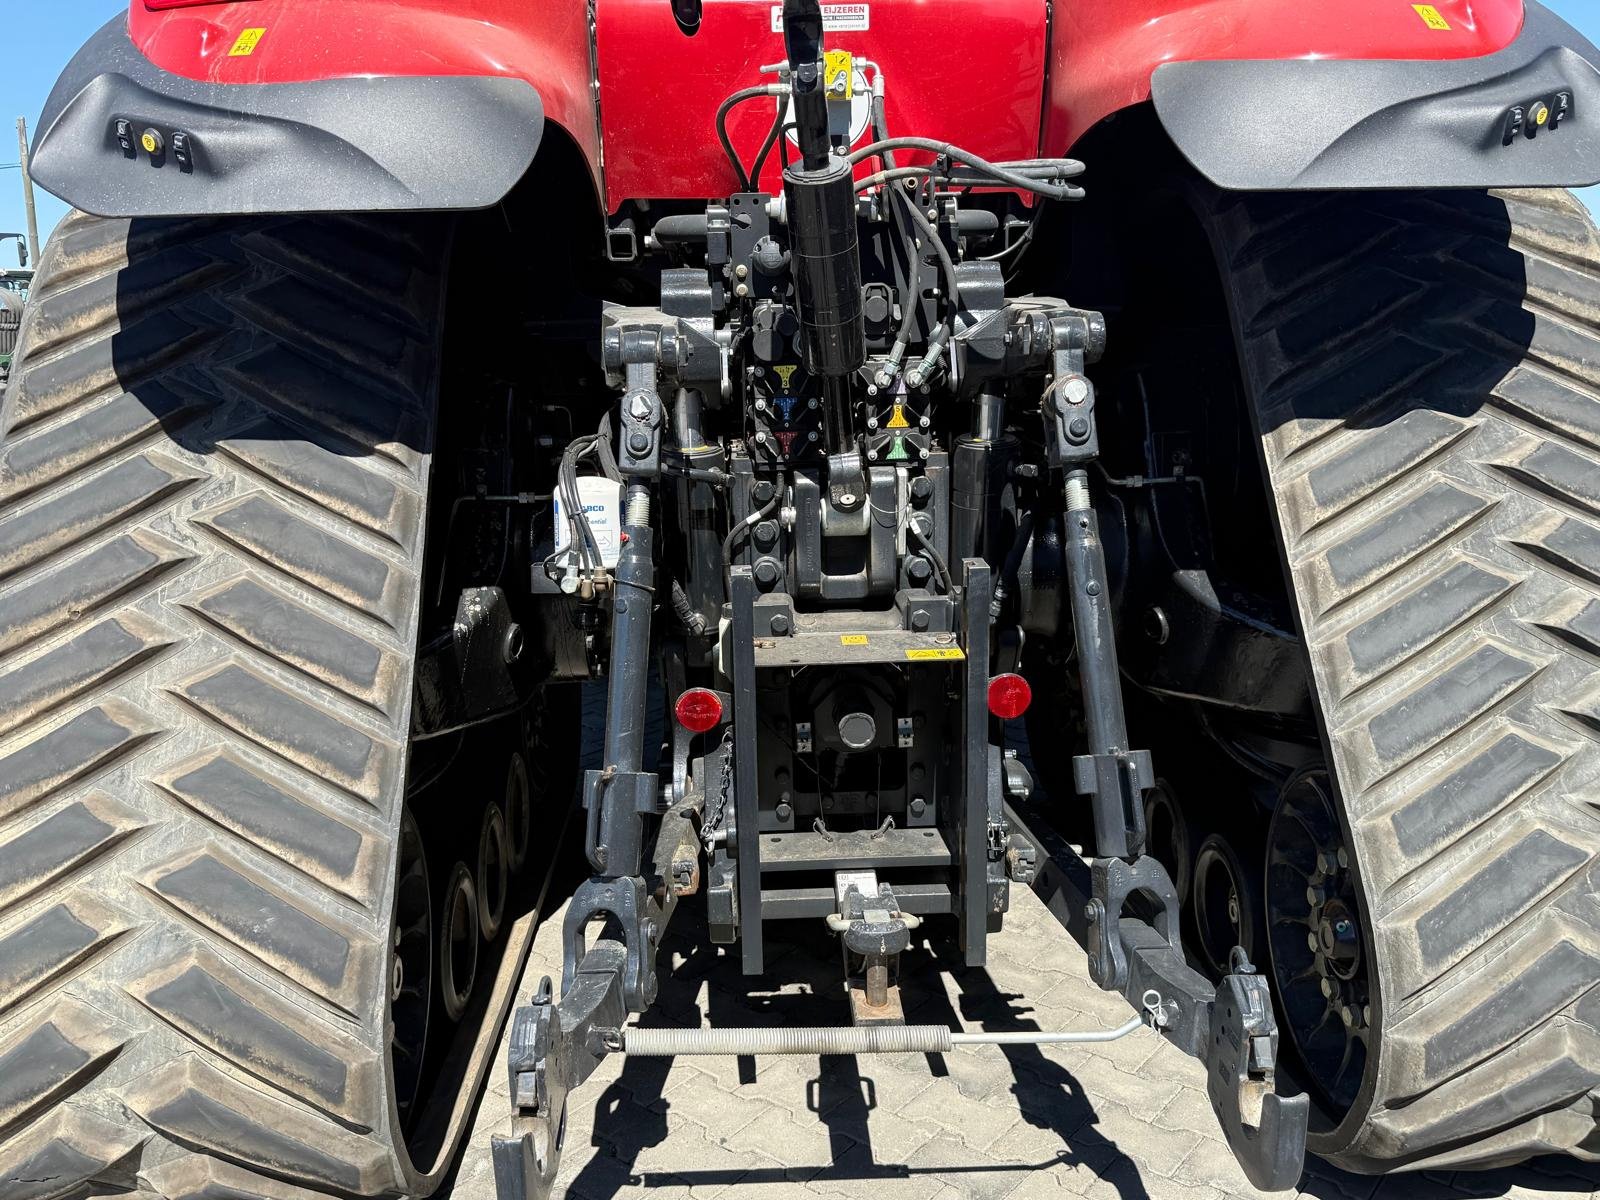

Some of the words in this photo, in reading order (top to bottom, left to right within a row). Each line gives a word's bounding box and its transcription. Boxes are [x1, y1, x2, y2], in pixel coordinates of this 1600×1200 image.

[824, 6, 865, 14] EIJZEREN
[783, 379, 788, 387] 3
[783, 412, 789, 420] 2
[582, 504, 605, 512] BCO
